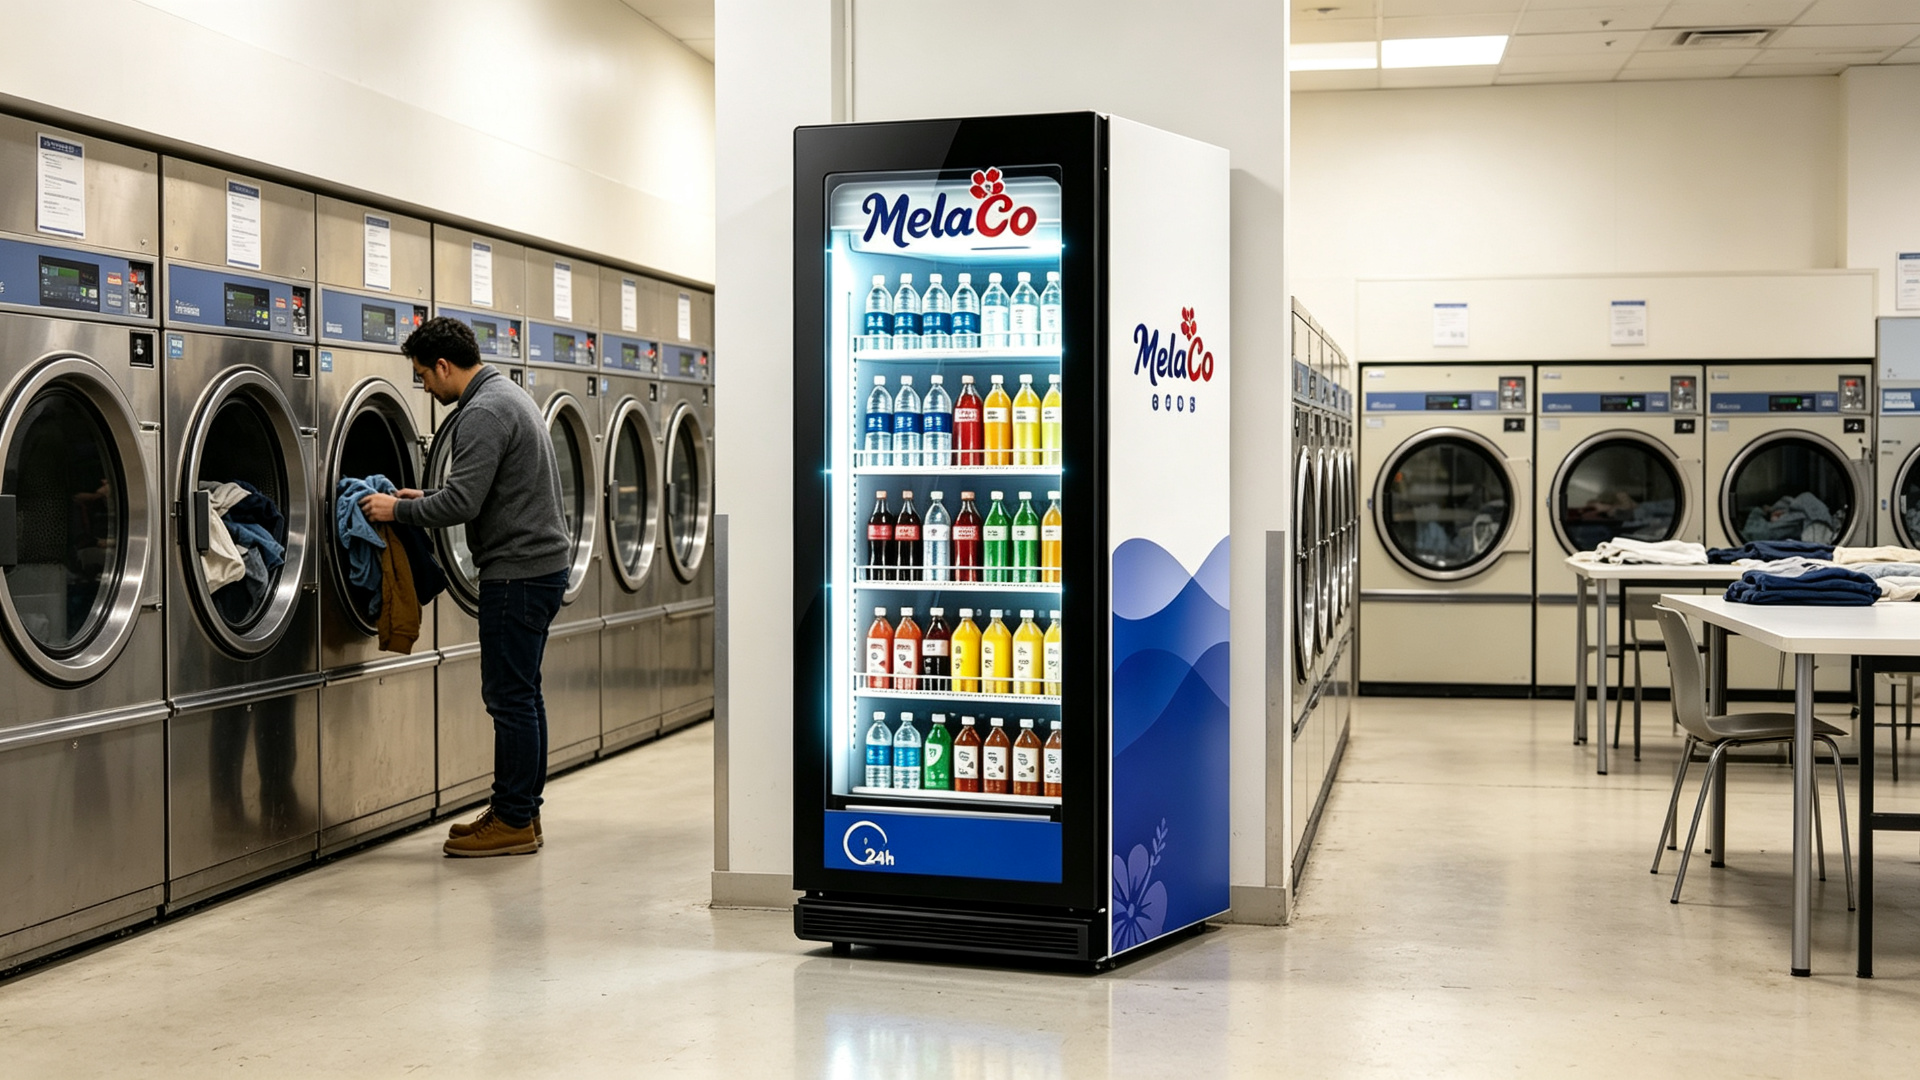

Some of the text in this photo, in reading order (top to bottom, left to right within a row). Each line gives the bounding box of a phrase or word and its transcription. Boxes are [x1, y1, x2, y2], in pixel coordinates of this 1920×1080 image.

[862, 192, 1037, 248] MelaCo
[1133, 323, 1214, 387] MelaCo
[864, 847, 895, 866] 24h
